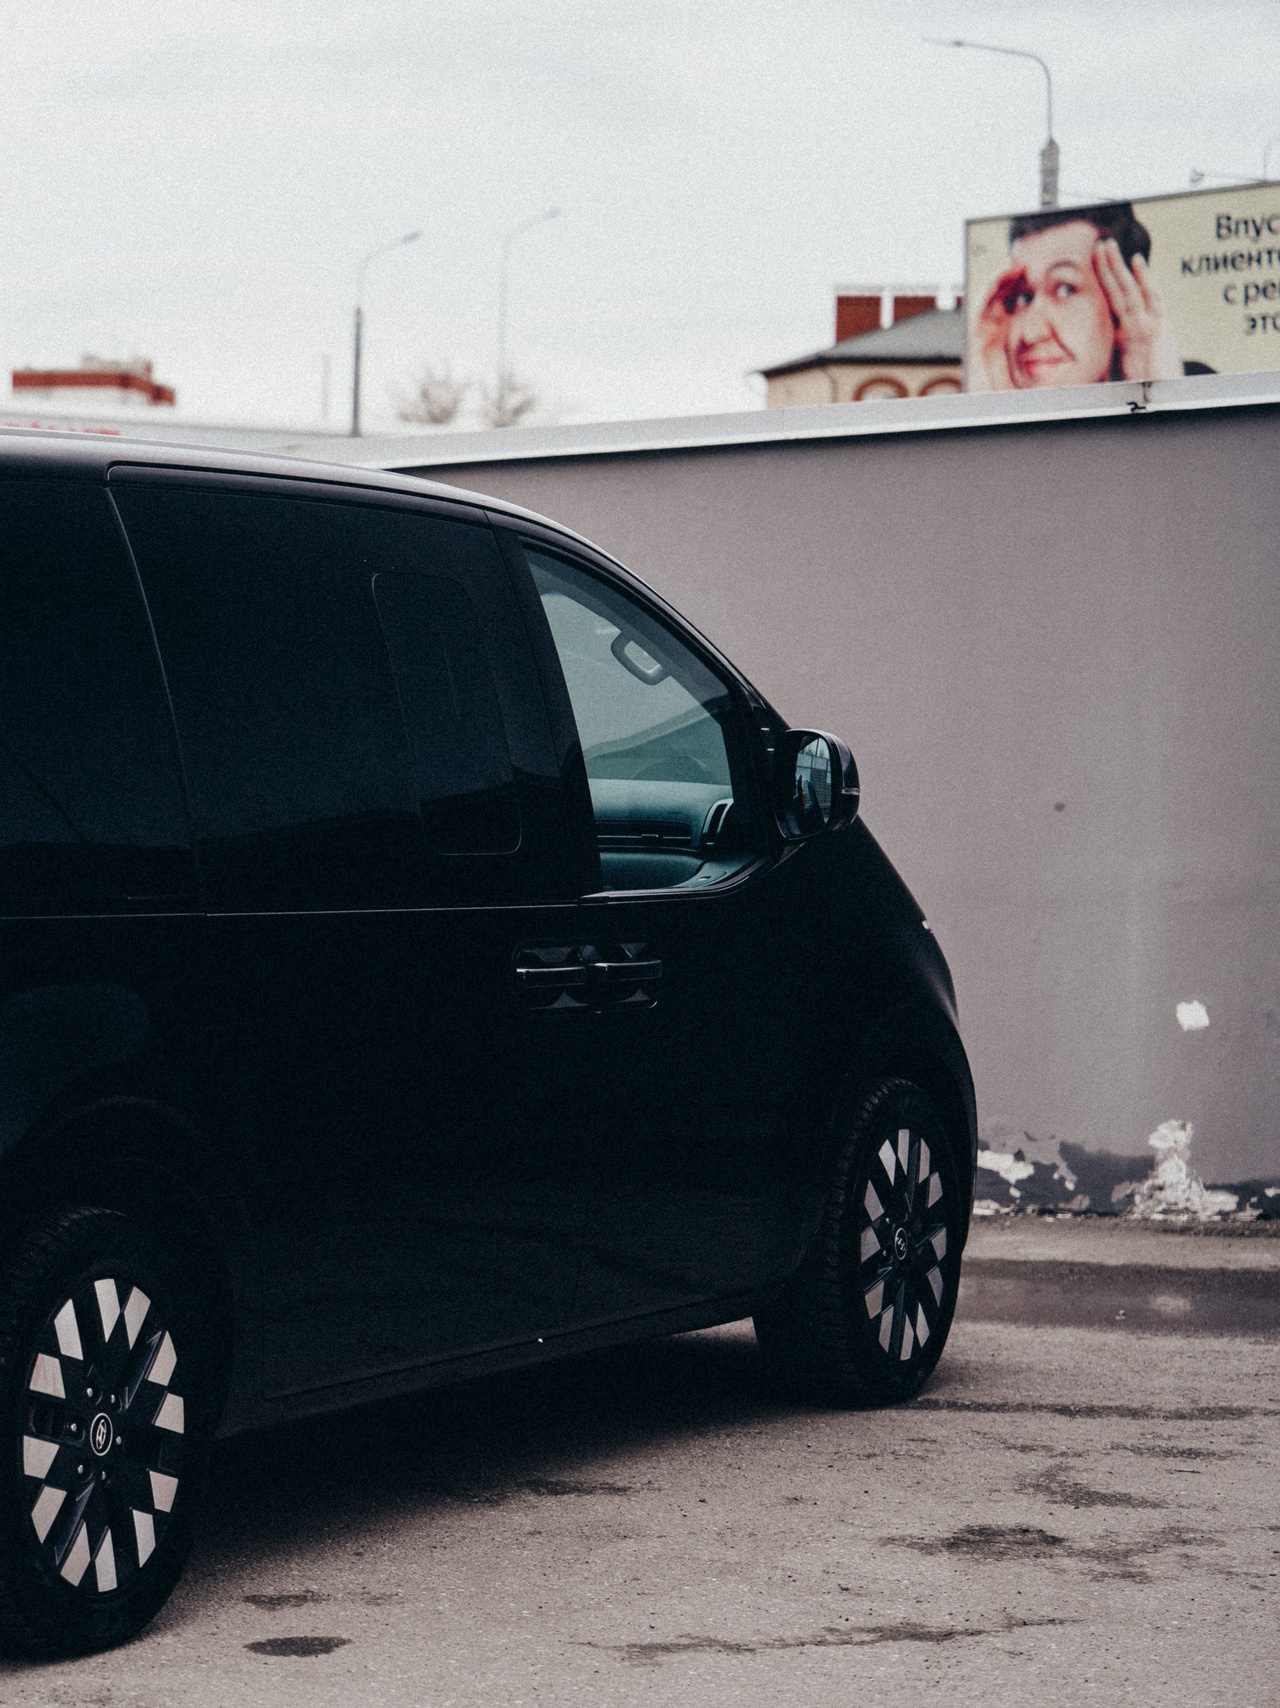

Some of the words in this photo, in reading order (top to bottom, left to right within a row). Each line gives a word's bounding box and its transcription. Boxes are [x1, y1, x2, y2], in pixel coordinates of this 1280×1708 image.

[1181, 248, 1280, 276] клиент
[1223, 282, 1237, 305] с
[1244, 278, 1280, 307] ре
